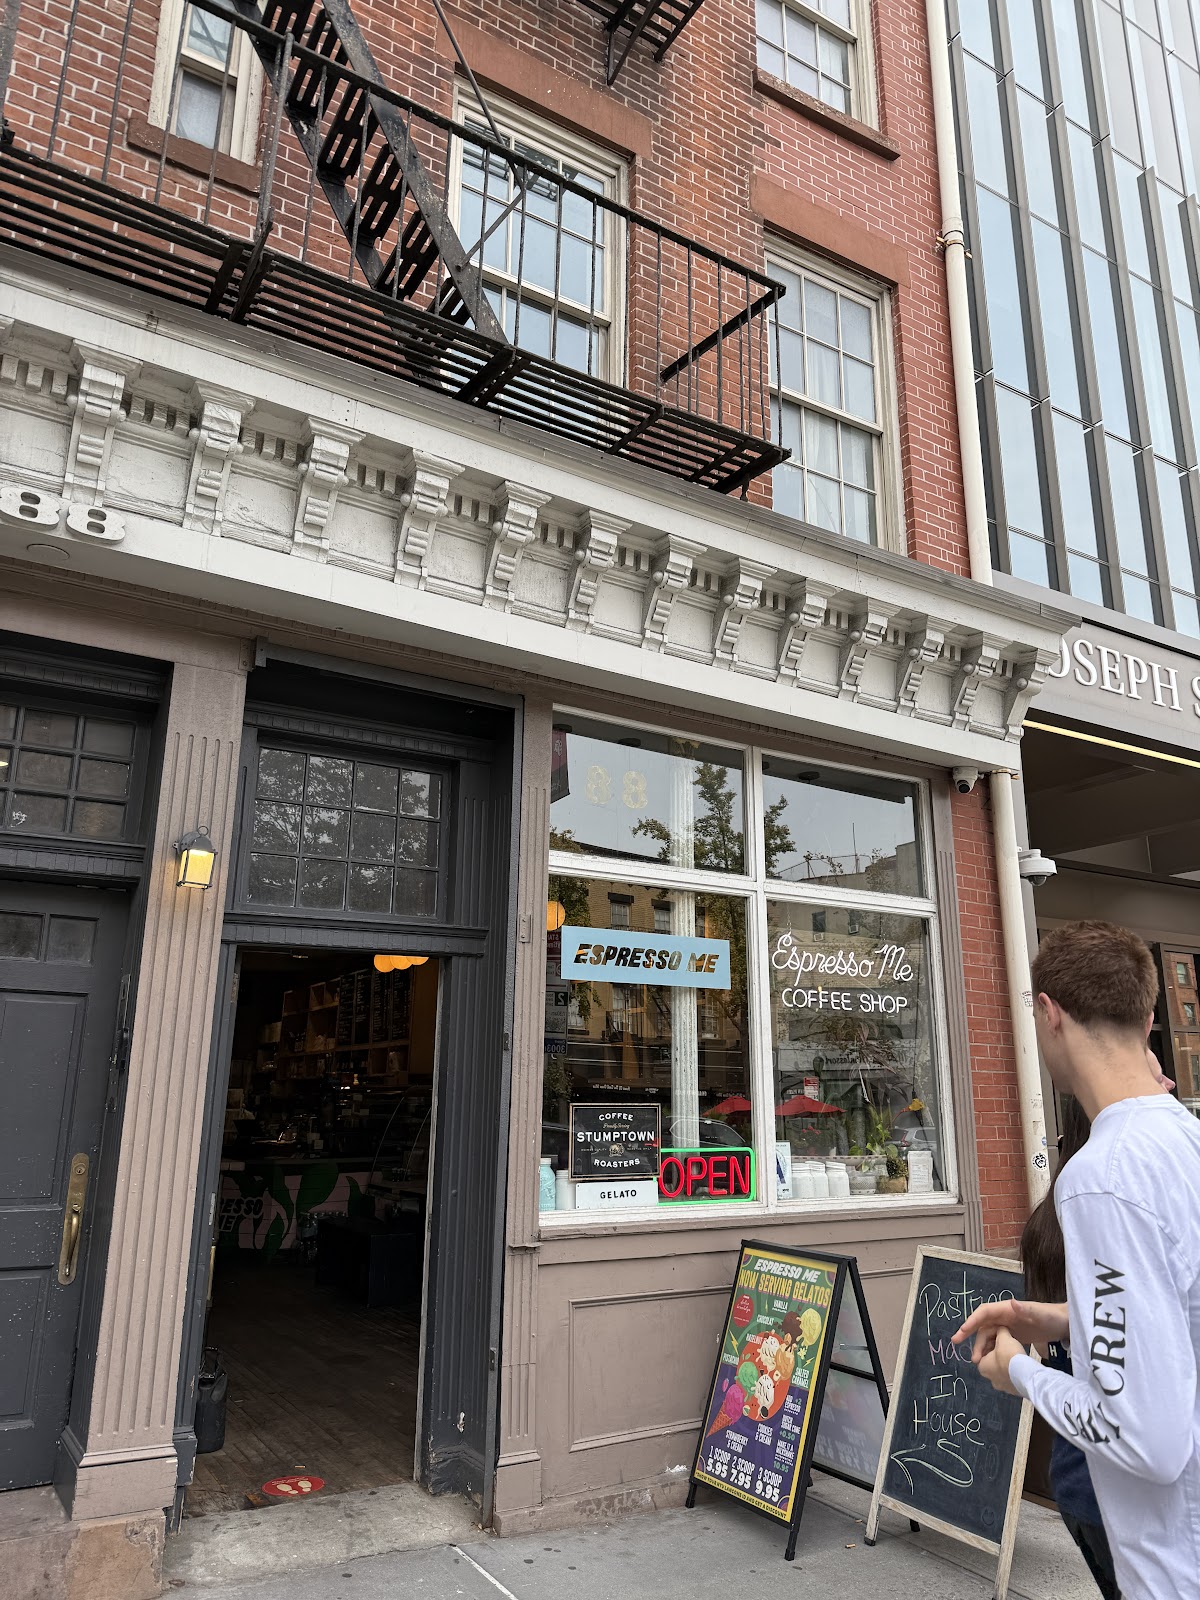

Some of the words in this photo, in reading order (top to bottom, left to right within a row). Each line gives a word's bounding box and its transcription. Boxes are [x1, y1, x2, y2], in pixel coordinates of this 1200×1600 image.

[573, 943, 682, 970] ESPRESSO
[686, 953, 719, 973] ME
[772, 931, 874, 986] Espresso
[874, 944, 914, 981] Me
[781, 987, 852, 1011] COFFEE
[859, 993, 908, 1013] SHOP
[598, 1112, 634, 1121] COFFEE
[576, 1131, 655, 1142] STUMPTOWN
[594, 1158, 641, 1168] ROASTERS
[659, 1156, 750, 1198] OPEN
[600, 1189, 637, 1199] GELATO
[754, 1259, 802, 1279] ESPRESSO
[802, 1269, 821, 1283] ME
[739, 1269, 759, 1290] NOW
[758, 1273, 793, 1298] SERVING
[792, 1281, 831, 1308] GELATOS
[773, 1300, 788, 1311] VANILLA
[1091, 1259, 1126, 1396] CREW
[791, 1375, 809, 1388] CARAMEL
[930, 1373, 968, 1400] In
[757, 1423, 773, 1436] COOKIES
[913, 1397, 984, 1445] House
[726, 1429, 749, 1446] STRAWBERRY
[730, 1441, 743, 1453] CREAM
[758, 1433, 772, 1446] CREAM
[709, 1446, 714, 1457] 1
[714, 1448, 731, 1464] SCOOP
[706, 1458, 728, 1478] 5.95
[732, 1456, 737, 1468] 2
[737, 1458, 755, 1475] SCOOP
[730, 1469, 752, 1489] 7.95
[758, 1467, 763, 1479] 3
[763, 1469, 782, 1487] SCOOP
[755, 1480, 780, 1502] 9.95
[766, 1505, 786, 1519] DISCOUNT
